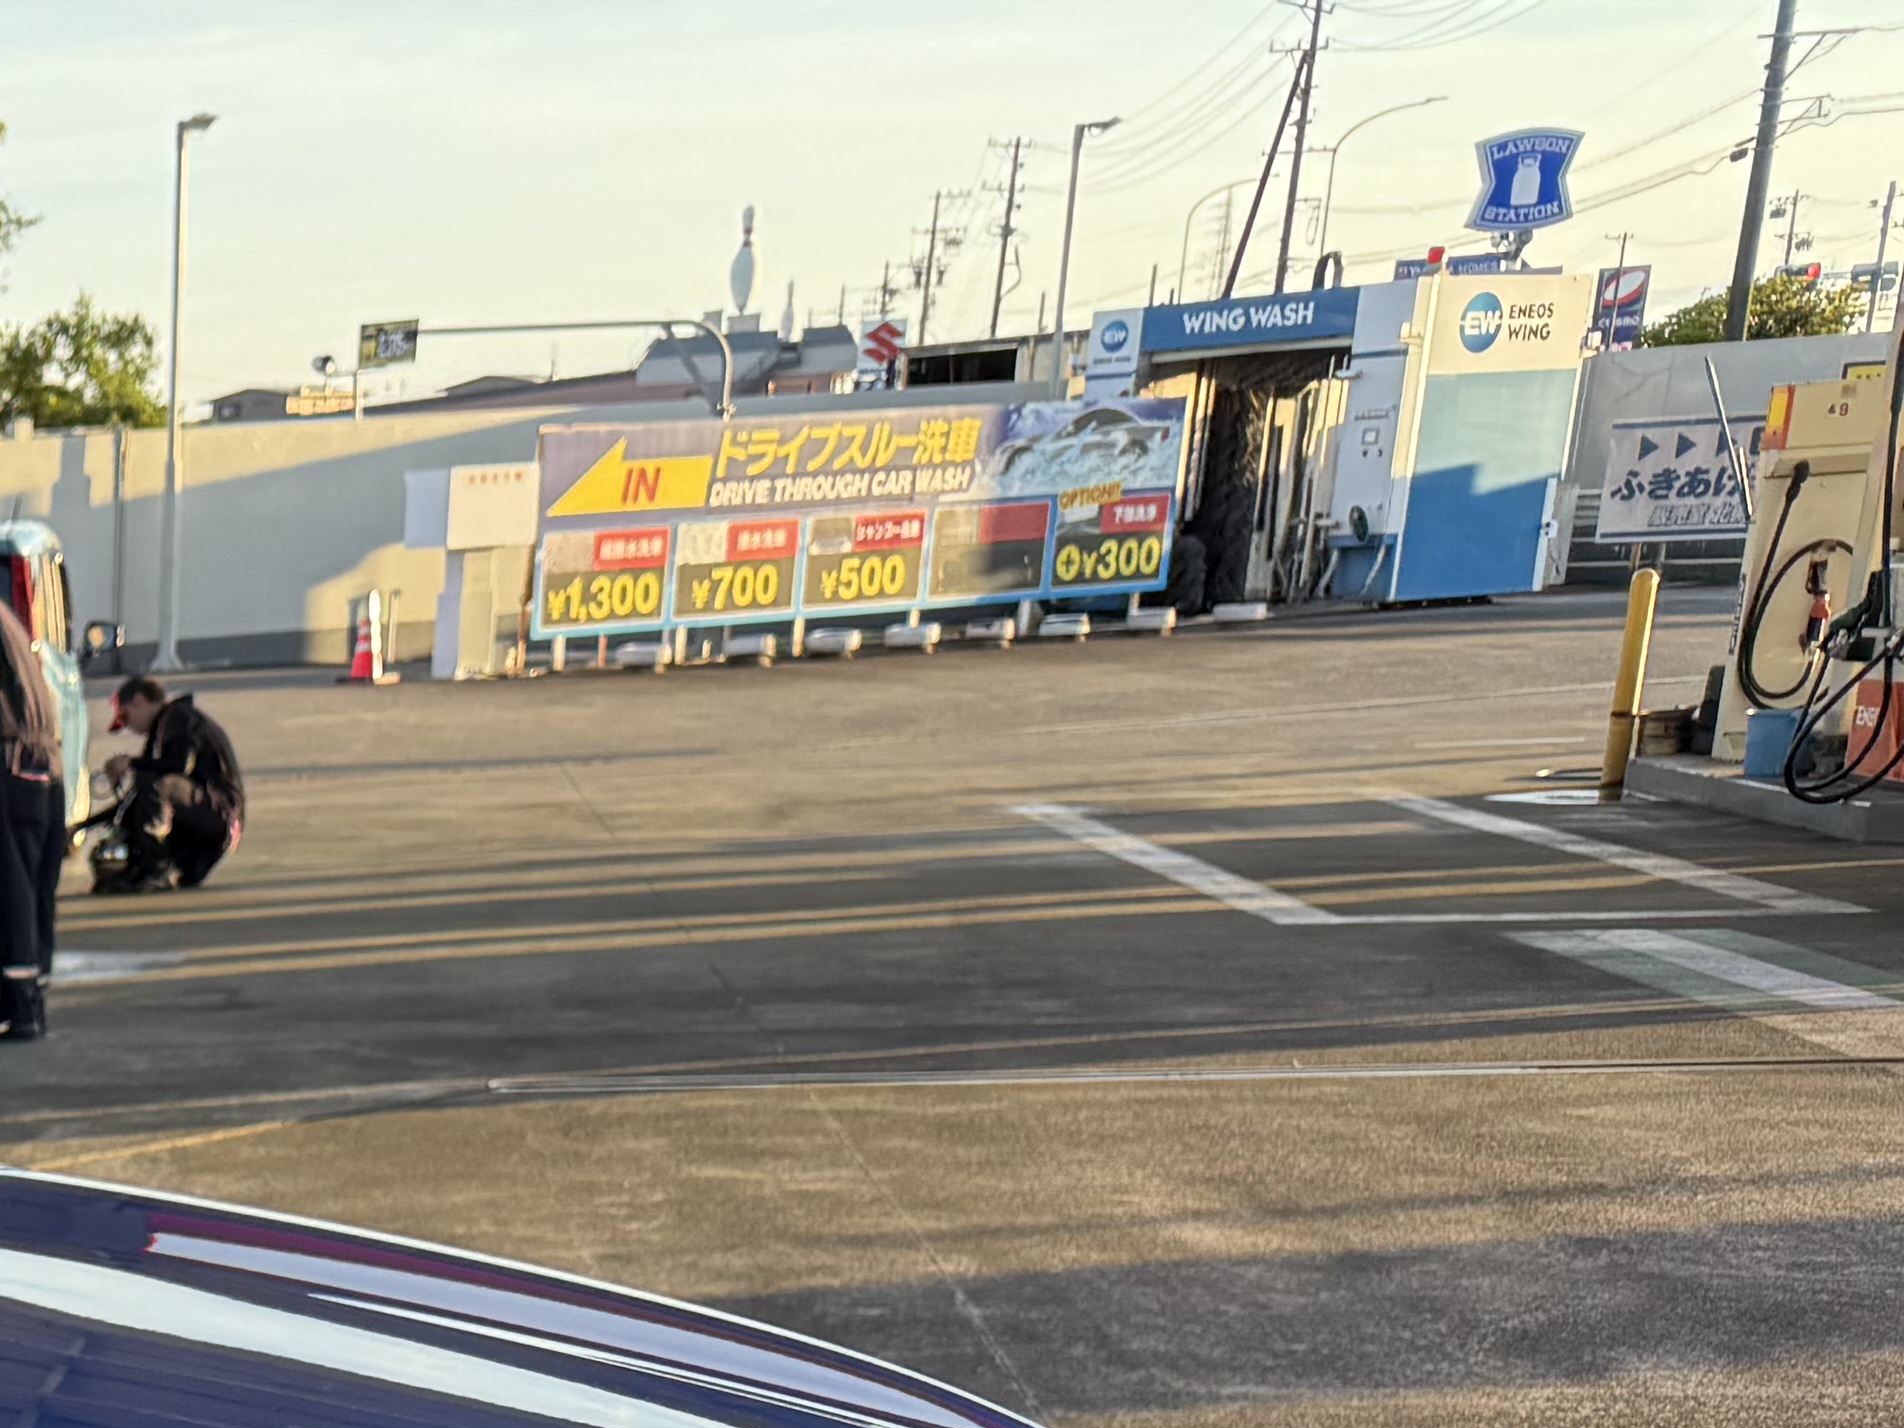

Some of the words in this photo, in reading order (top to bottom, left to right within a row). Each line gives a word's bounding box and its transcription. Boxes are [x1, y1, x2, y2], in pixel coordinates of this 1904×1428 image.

[1492, 137, 1570, 159] LAWSON
[1484, 202, 1560, 222] STATION
[1183, 307, 1244, 335] WING
[1249, 301, 1315, 328] WASH
[1508, 302, 1554, 319] ENEOS
[1508, 322, 1551, 341] WING
[715, 417, 983, 479] ドライブスルー洗車
[621, 466, 662, 505] IN
[709, 477, 771, 508] DRIVE
[773, 472, 870, 502] THROUGH
[871, 470, 913, 497] CAR
[915, 466, 971, 493] WASH
[691, 564, 779, 611] ¥700
[820, 555, 906, 600] ¥500
[547, 573, 660, 624] ¥1,300
